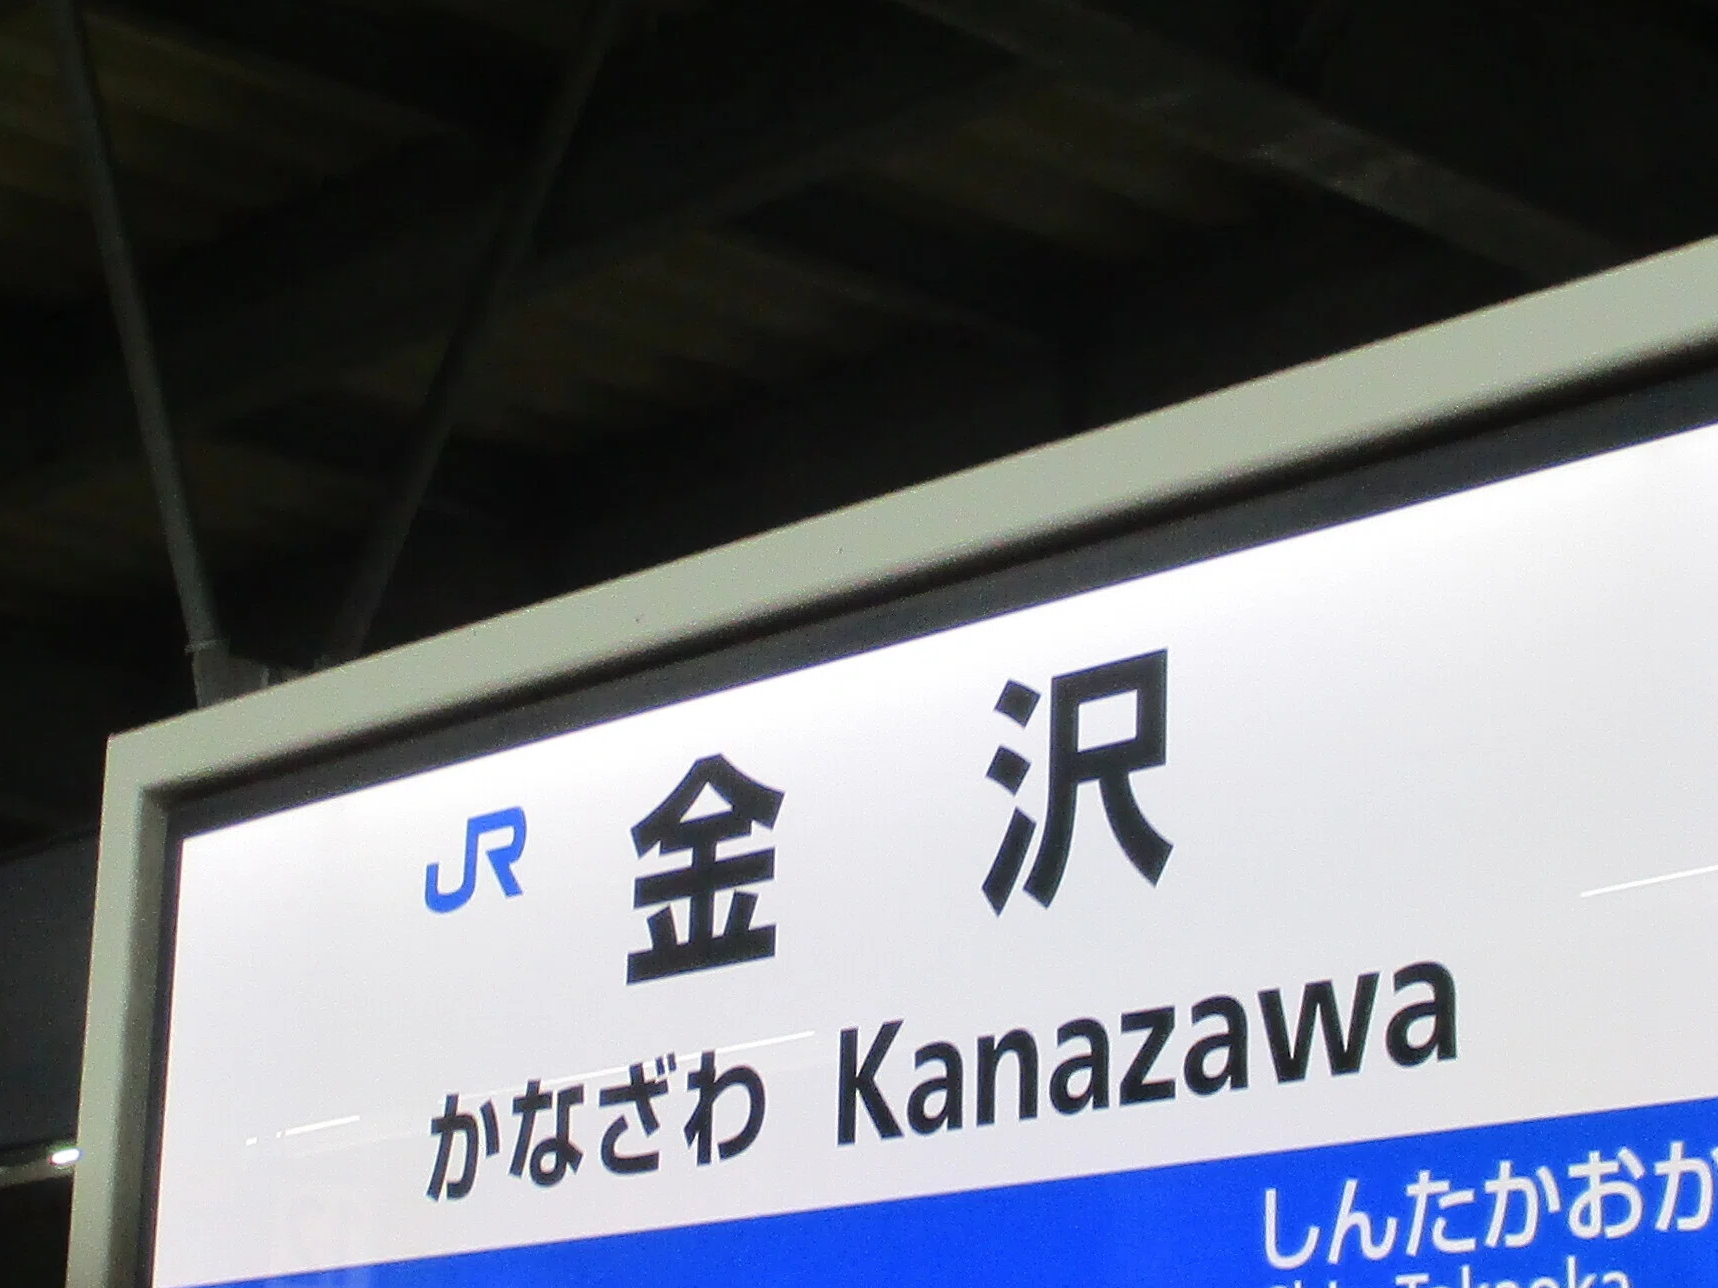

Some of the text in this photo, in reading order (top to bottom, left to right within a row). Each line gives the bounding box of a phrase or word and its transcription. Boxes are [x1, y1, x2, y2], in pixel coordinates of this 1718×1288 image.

[424, 806, 527, 914] JR
[625, 648, 1174, 985] 金沢
[426, 959, 1459, 1202] かなざわ Kanazawa
